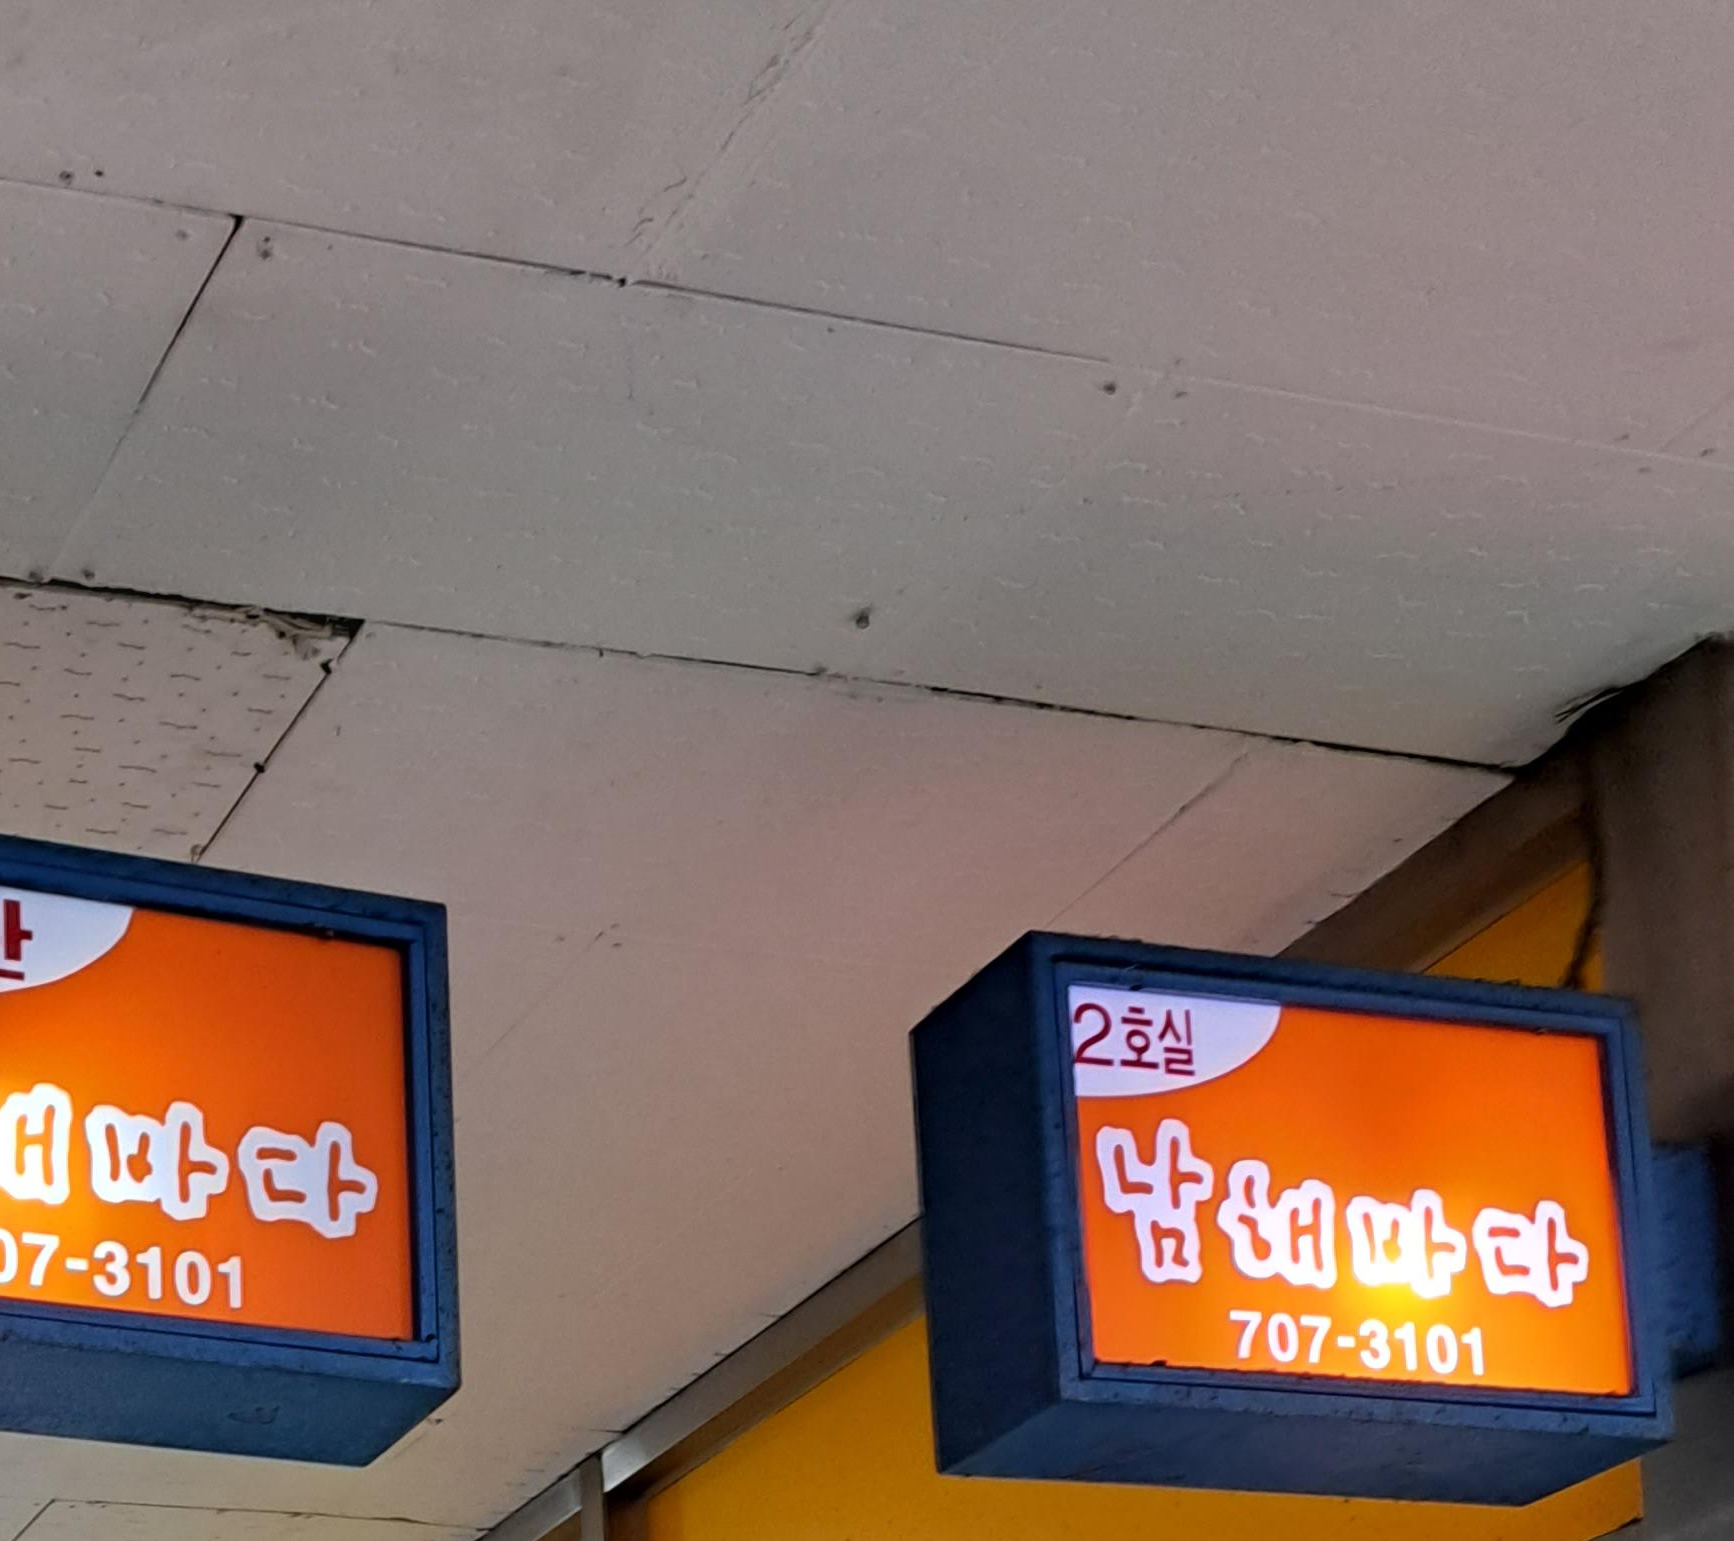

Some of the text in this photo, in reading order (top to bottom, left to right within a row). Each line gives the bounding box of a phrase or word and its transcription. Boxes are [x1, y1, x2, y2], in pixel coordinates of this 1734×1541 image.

[1073, 1003, 1196, 1076] 2호실
[1095, 1117, 1589, 1308] 남해바다
[1228, 1309, 1484, 1376] 707-3101
